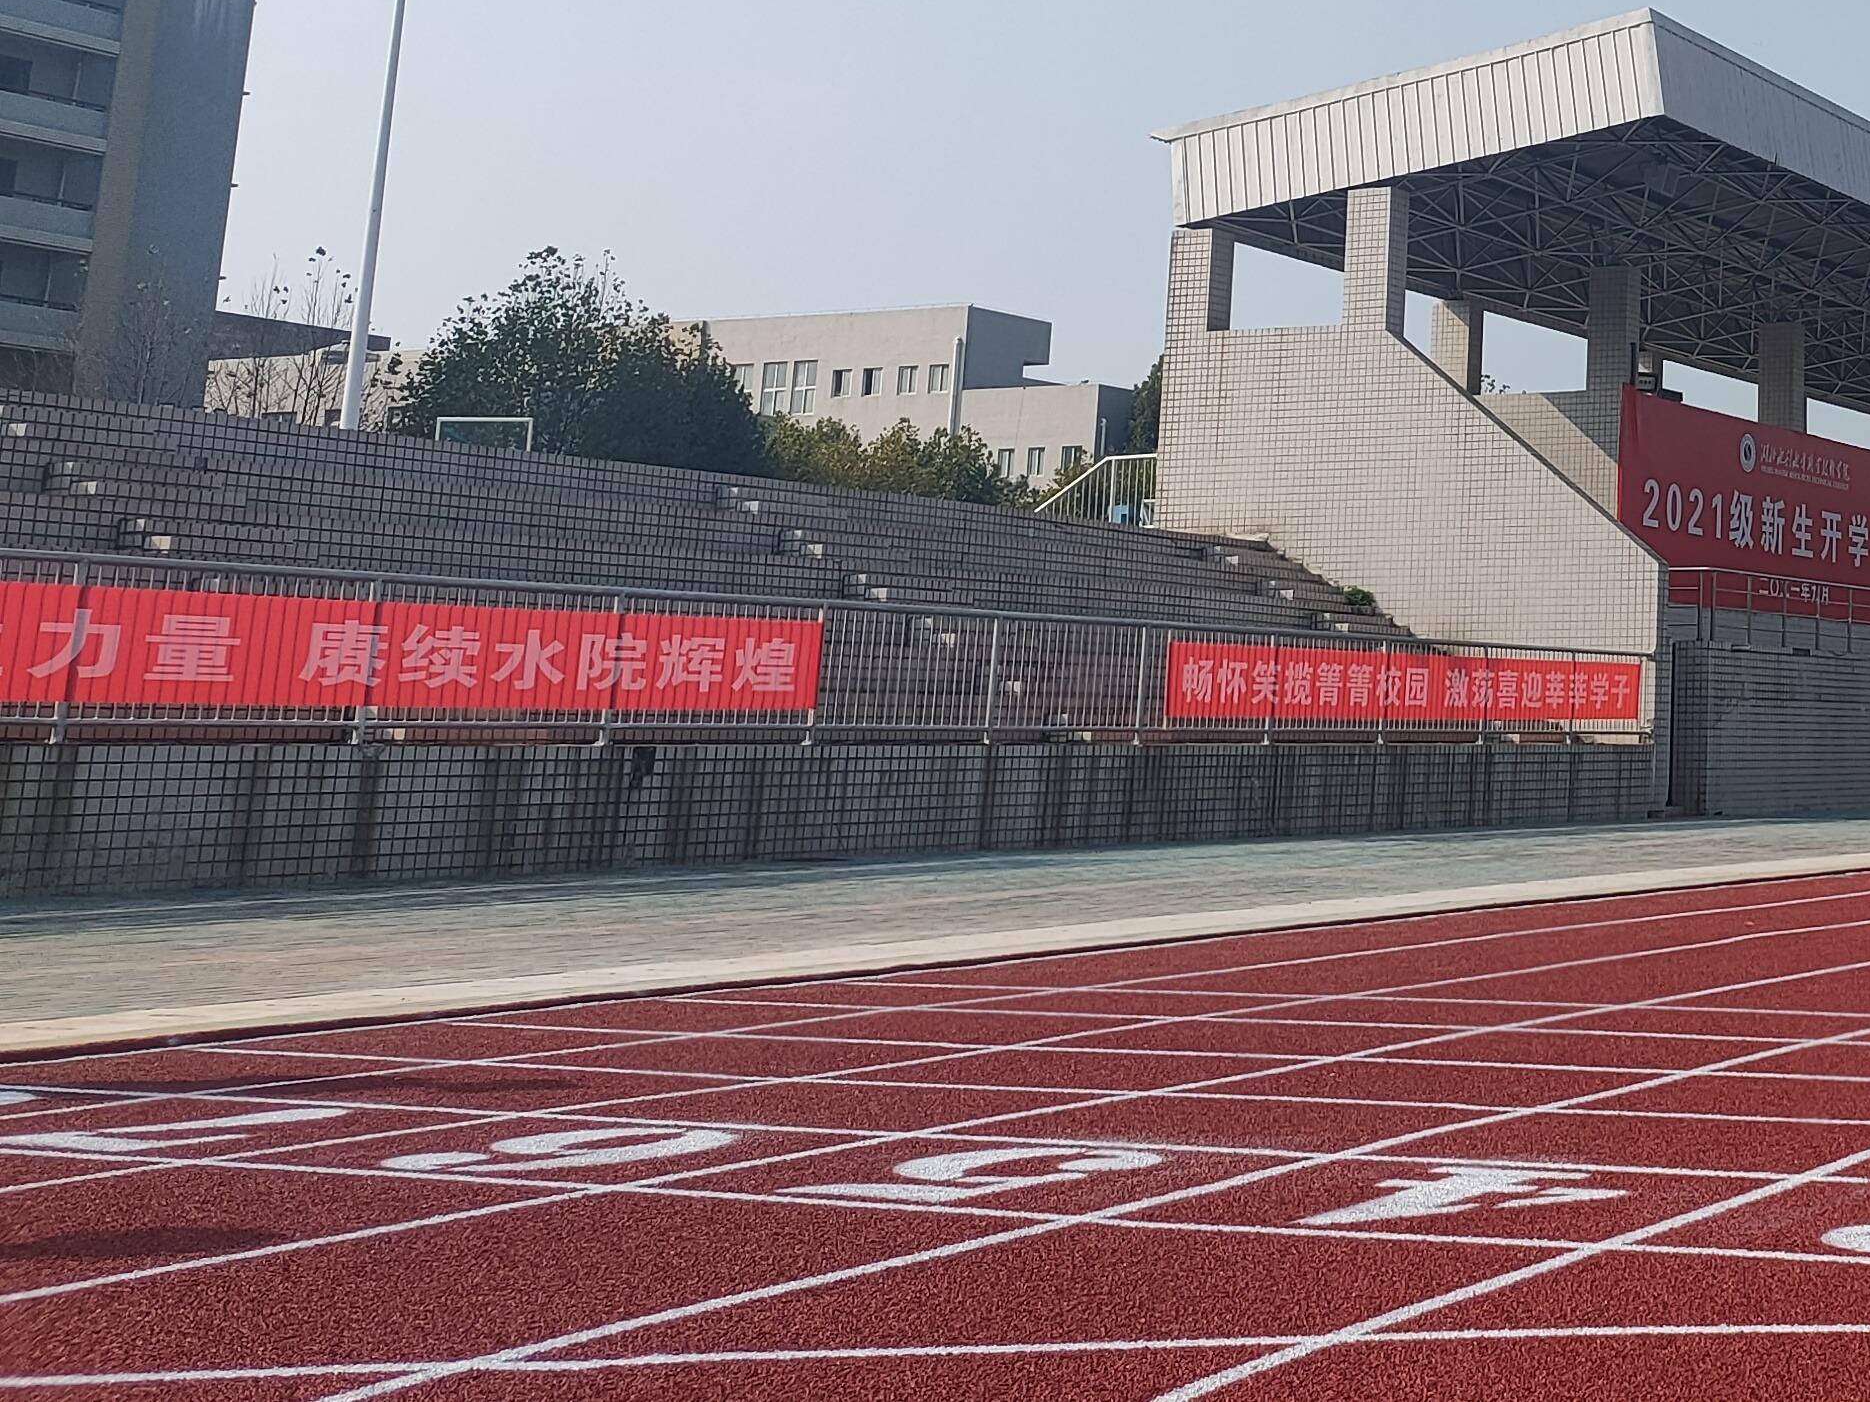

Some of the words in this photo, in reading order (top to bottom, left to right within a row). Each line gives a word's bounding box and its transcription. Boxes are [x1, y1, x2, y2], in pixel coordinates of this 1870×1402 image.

[0, 607, 241, 682] 力量
[298, 619, 797, 694] 赓续水院辉煌
